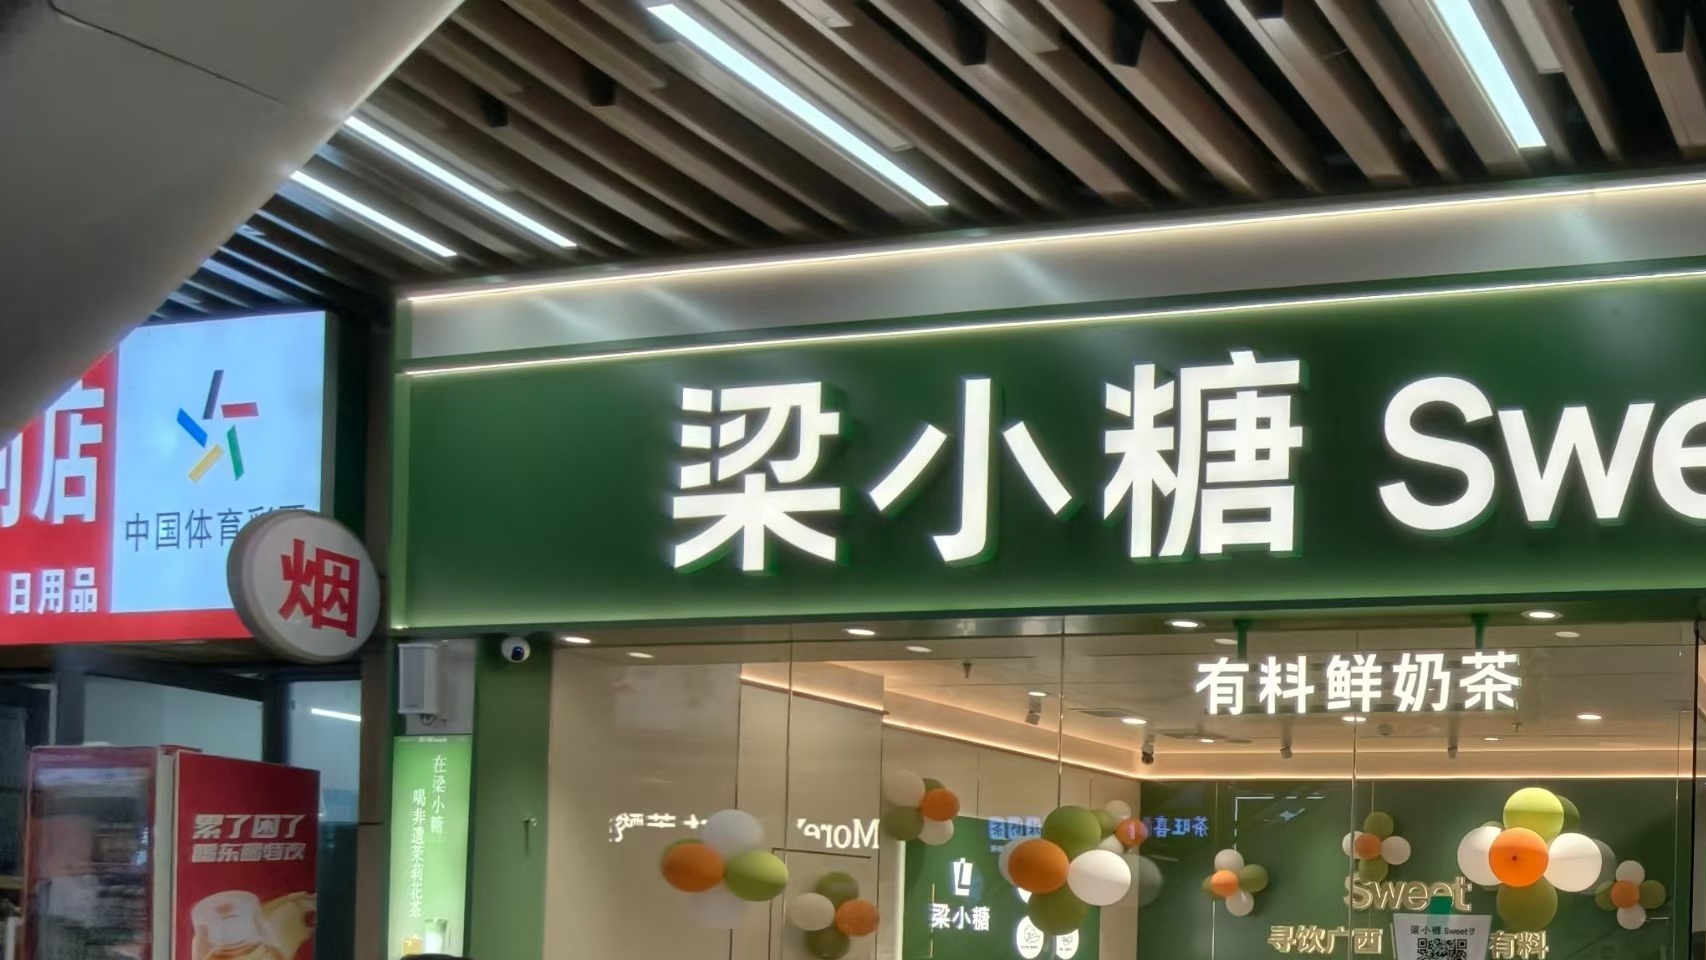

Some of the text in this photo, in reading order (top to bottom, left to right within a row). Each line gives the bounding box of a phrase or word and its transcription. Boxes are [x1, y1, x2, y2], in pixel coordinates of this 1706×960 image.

[670, 350, 1302, 574] 梁小糖
[125, 504, 305, 552] 中国体育
[10, 567, 98, 614] 日用品
[278, 538, 361, 638] 烟
[1194, 651, 1521, 715] 有料鲜奶茶
[191, 814, 306, 839] 累了困了
[1344, 873, 1472, 912] Sweet
[931, 902, 990, 931] 梁小糖
[1267, 925, 1550, 960] 寻饮广西 有料
